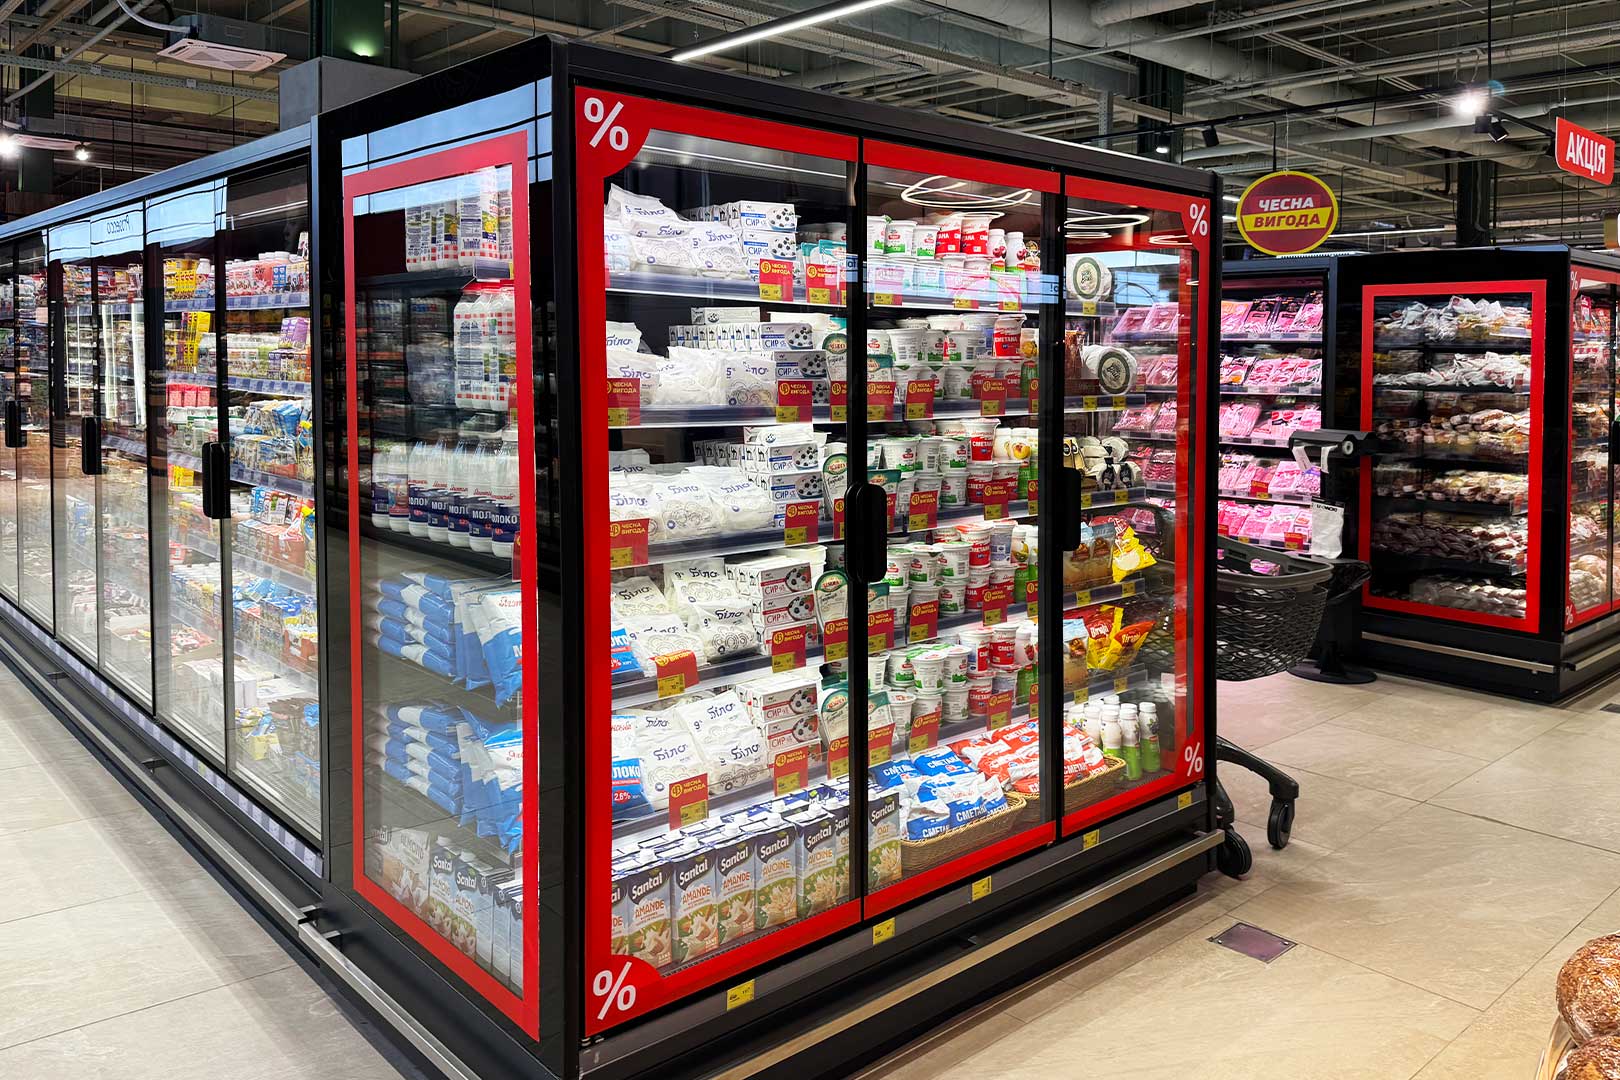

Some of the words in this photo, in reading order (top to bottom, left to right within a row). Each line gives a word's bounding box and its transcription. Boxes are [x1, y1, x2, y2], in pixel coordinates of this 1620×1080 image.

[583, 97, 629, 151] %
[1565, 130, 1607, 175] АКЦІЯ
[1258, 196, 1315, 212] ЧЕСНА
[1189, 203, 1208, 236] %
[1253, 212, 1322, 229] ВИГОДА
[748, 247, 762, 255] СИР
[1570, 271, 1579, 291] %
[765, 340, 779, 348] СИР
[777, 368, 792, 376] СИР
[773, 461, 787, 470] СИР
[774, 490, 789, 499] СИР
[764, 584, 779, 595] СИР
[766, 613, 781, 624] СИР
[707, 702, 736, 719] Біло
[766, 708, 782, 719] СИР
[731, 743, 760, 760] Біло
[771, 737, 785, 748] СИР
[653, 743, 688, 761] Біло
[1184, 742, 1203, 777] %
[872, 801, 895, 822] Santal
[807, 825, 832, 848] Santal
[760, 836, 790, 859] Santal
[720, 846, 749, 872] Santal
[762, 858, 791, 877] AVOINE
[679, 858, 709, 886] Santal
[722, 871, 751, 889] AMANDE
[632, 872, 663, 900] Santal
[682, 885, 712, 905] AMANDE
[635, 899, 665, 919] AMANDE
[593, 961, 637, 1020] %
